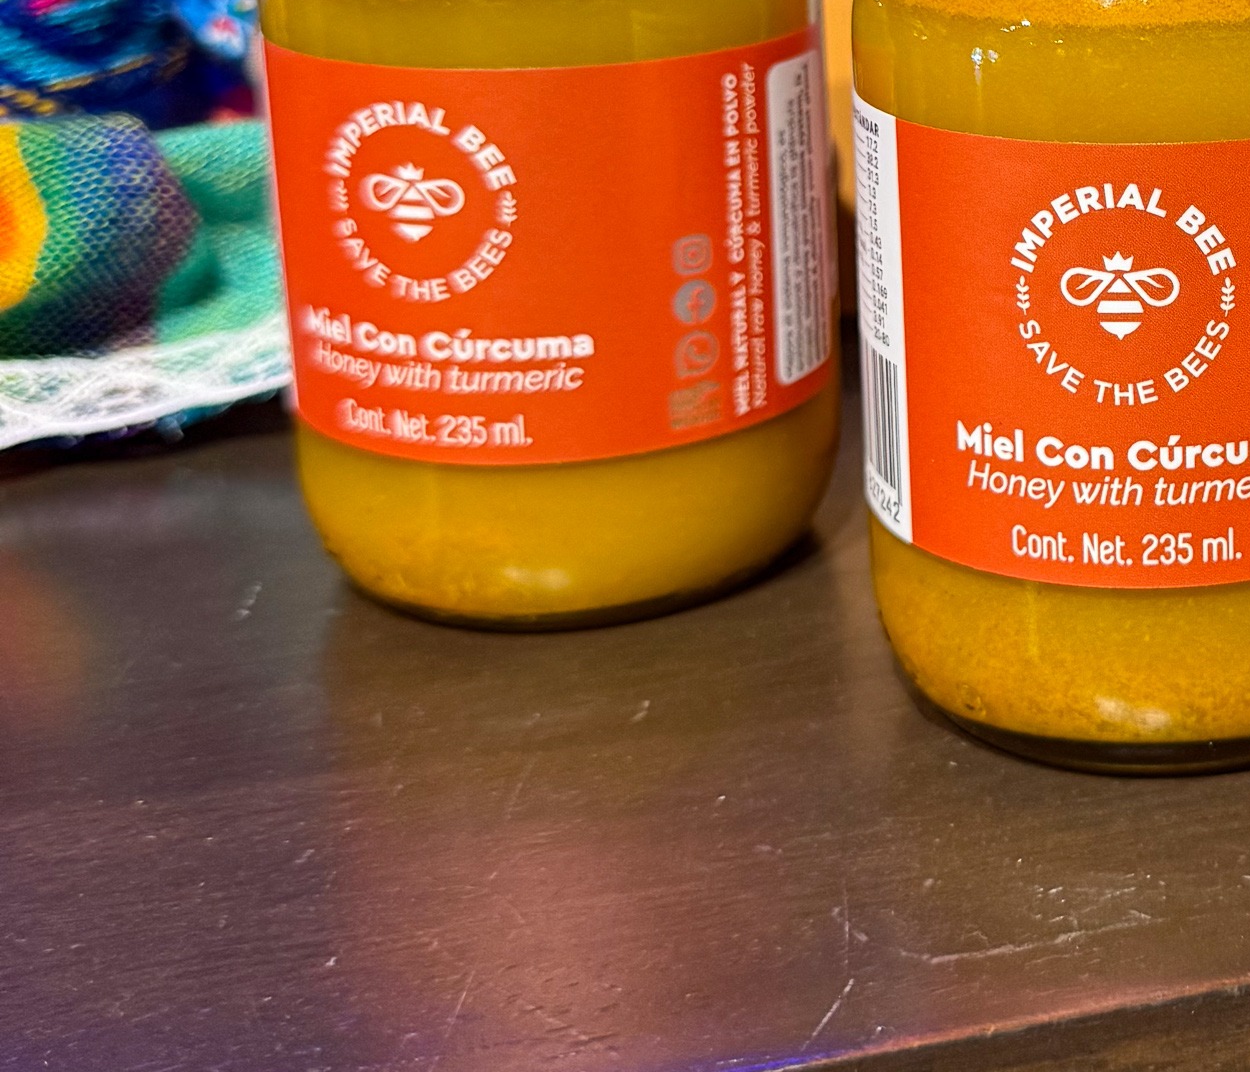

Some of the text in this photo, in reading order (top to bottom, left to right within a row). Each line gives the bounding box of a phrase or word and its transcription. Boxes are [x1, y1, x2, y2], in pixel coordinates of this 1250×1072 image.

[721, 73, 740, 137] POLVO
[741, 61, 760, 134] powder
[323, 100, 517, 191] IMPERIAL BEE
[723, 139, 741, 168] EN
[744, 137, 762, 217] turmeric
[723, 169, 745, 264] CÚRCUMA
[1010, 182, 1237, 276] IMPERIAL BEE
[334, 217, 513, 303] SAVE THE BEES
[748, 238, 766, 296] honey
[306, 304, 595, 362] Miel Con Cúrcuma
[729, 285, 750, 371] NATURAL
[315, 340, 584, 393] Honey with turmeric
[1019, 319, 1230, 406] SAVE THE BEES
[338, 398, 533, 446] Cont. Net. 235 ml.
[956, 419, 1024, 462] Miel
[1035, 435, 1114, 470] Con
[967, 460, 1065, 508] Honey
[1072, 476, 1144, 506] with
[1012, 524, 1243, 566] Cont. Net. 235 ml.
